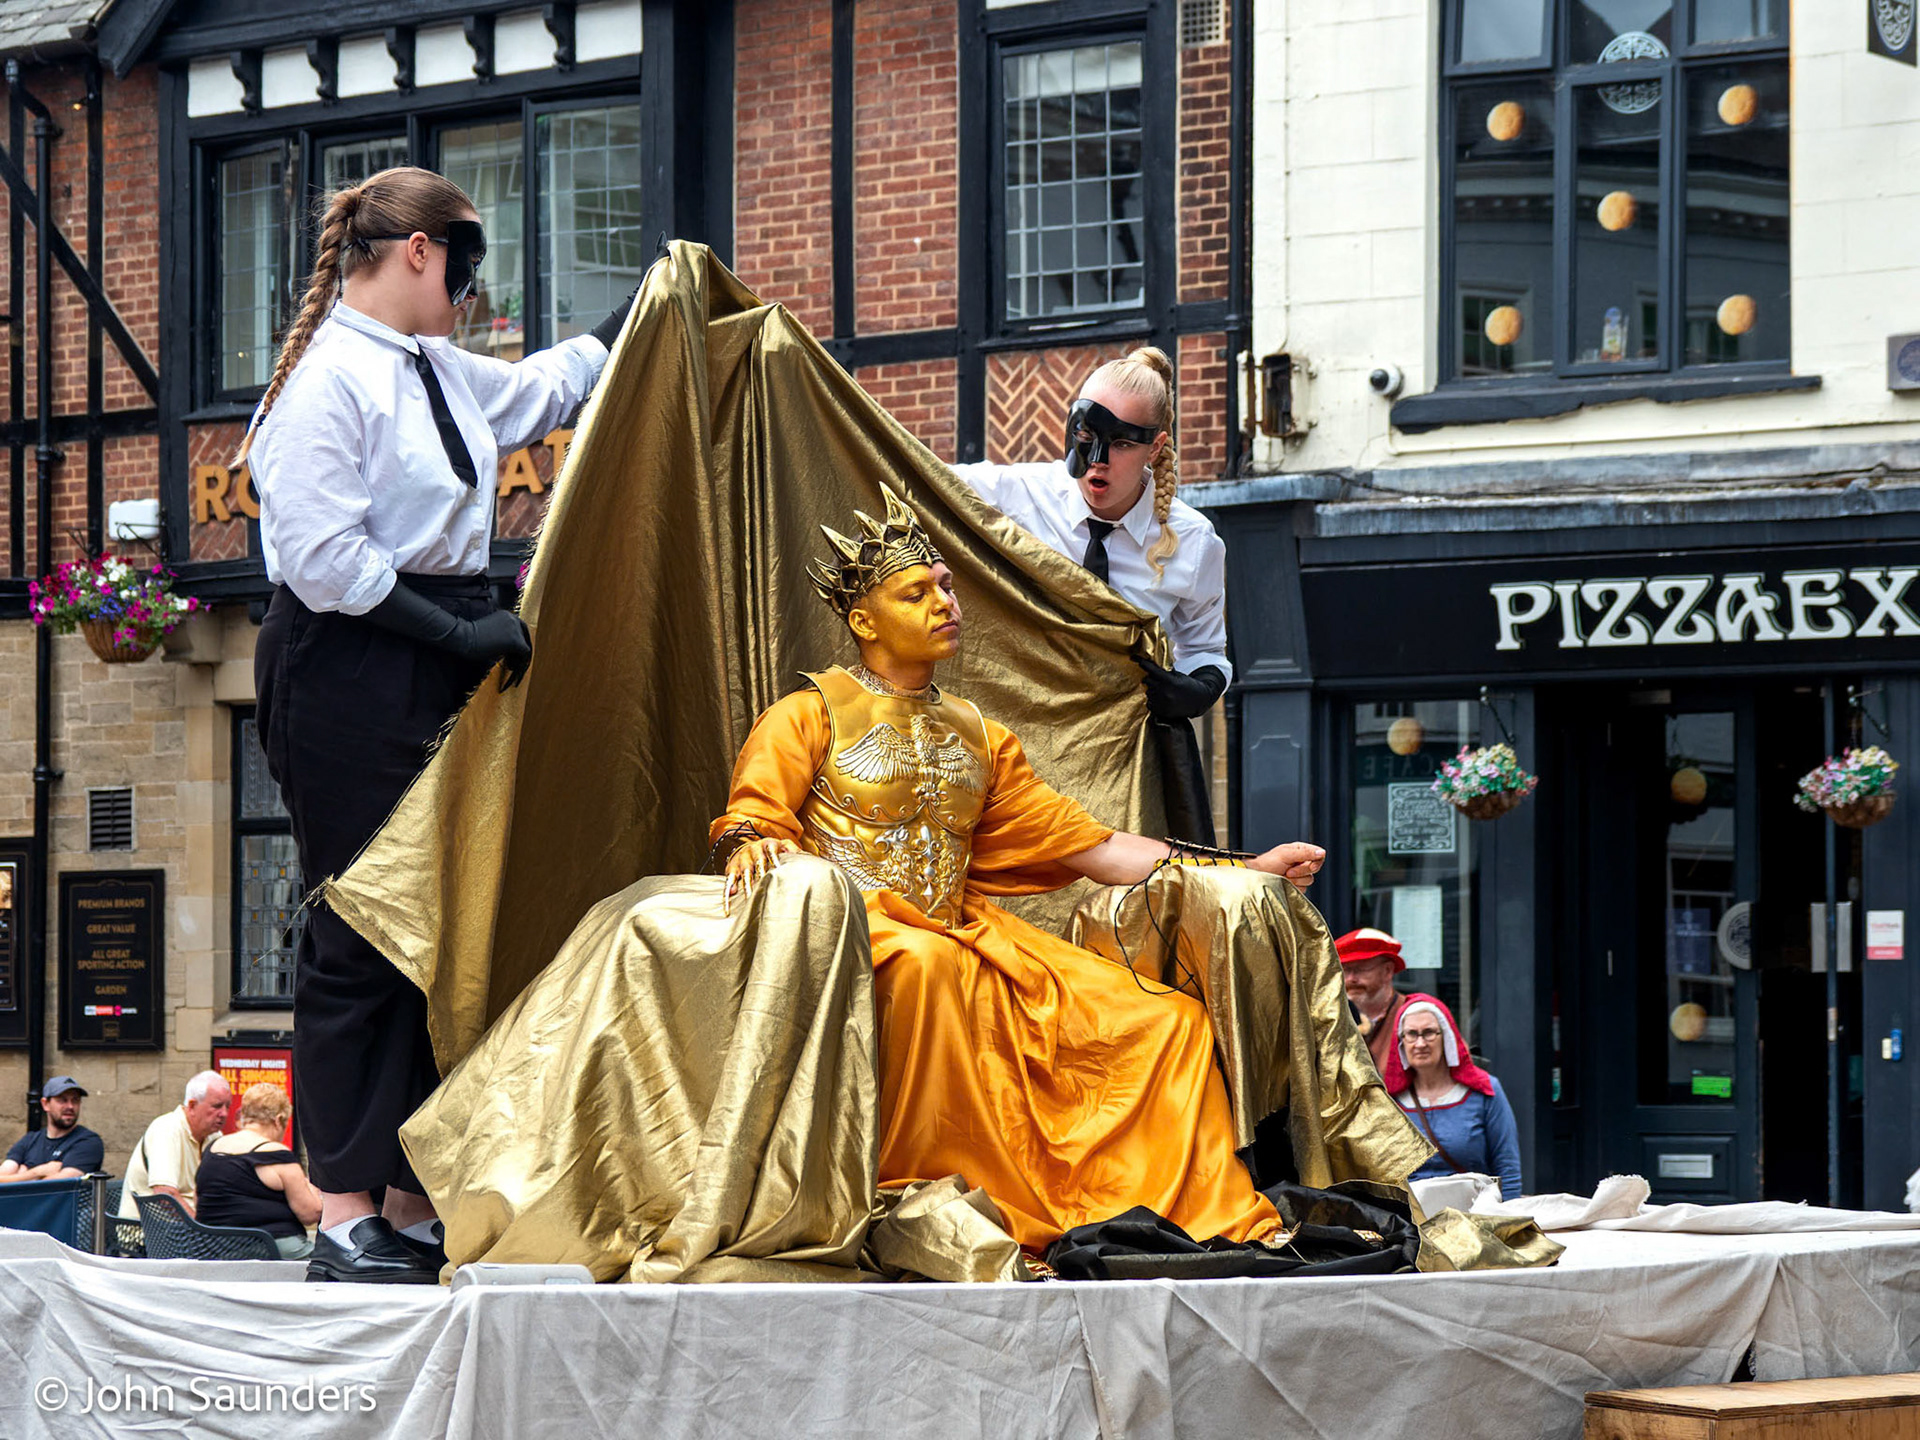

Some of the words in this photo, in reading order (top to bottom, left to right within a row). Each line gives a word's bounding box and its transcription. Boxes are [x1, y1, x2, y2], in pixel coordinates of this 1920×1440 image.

[77, 900, 113, 909] PREMIUM
[114, 898, 145, 908] BRANDS
[86, 925, 111, 934] GREAT
[111, 924, 136, 933] VALUE
[92, 950, 105, 959] ALL
[106, 949, 131, 959] GREAT
[77, 960, 115, 970] SPORTING
[116, 960, 145, 970] ACTION
[95, 985, 127, 995] GARDEN
[239, 1070, 287, 1084] SINGING
